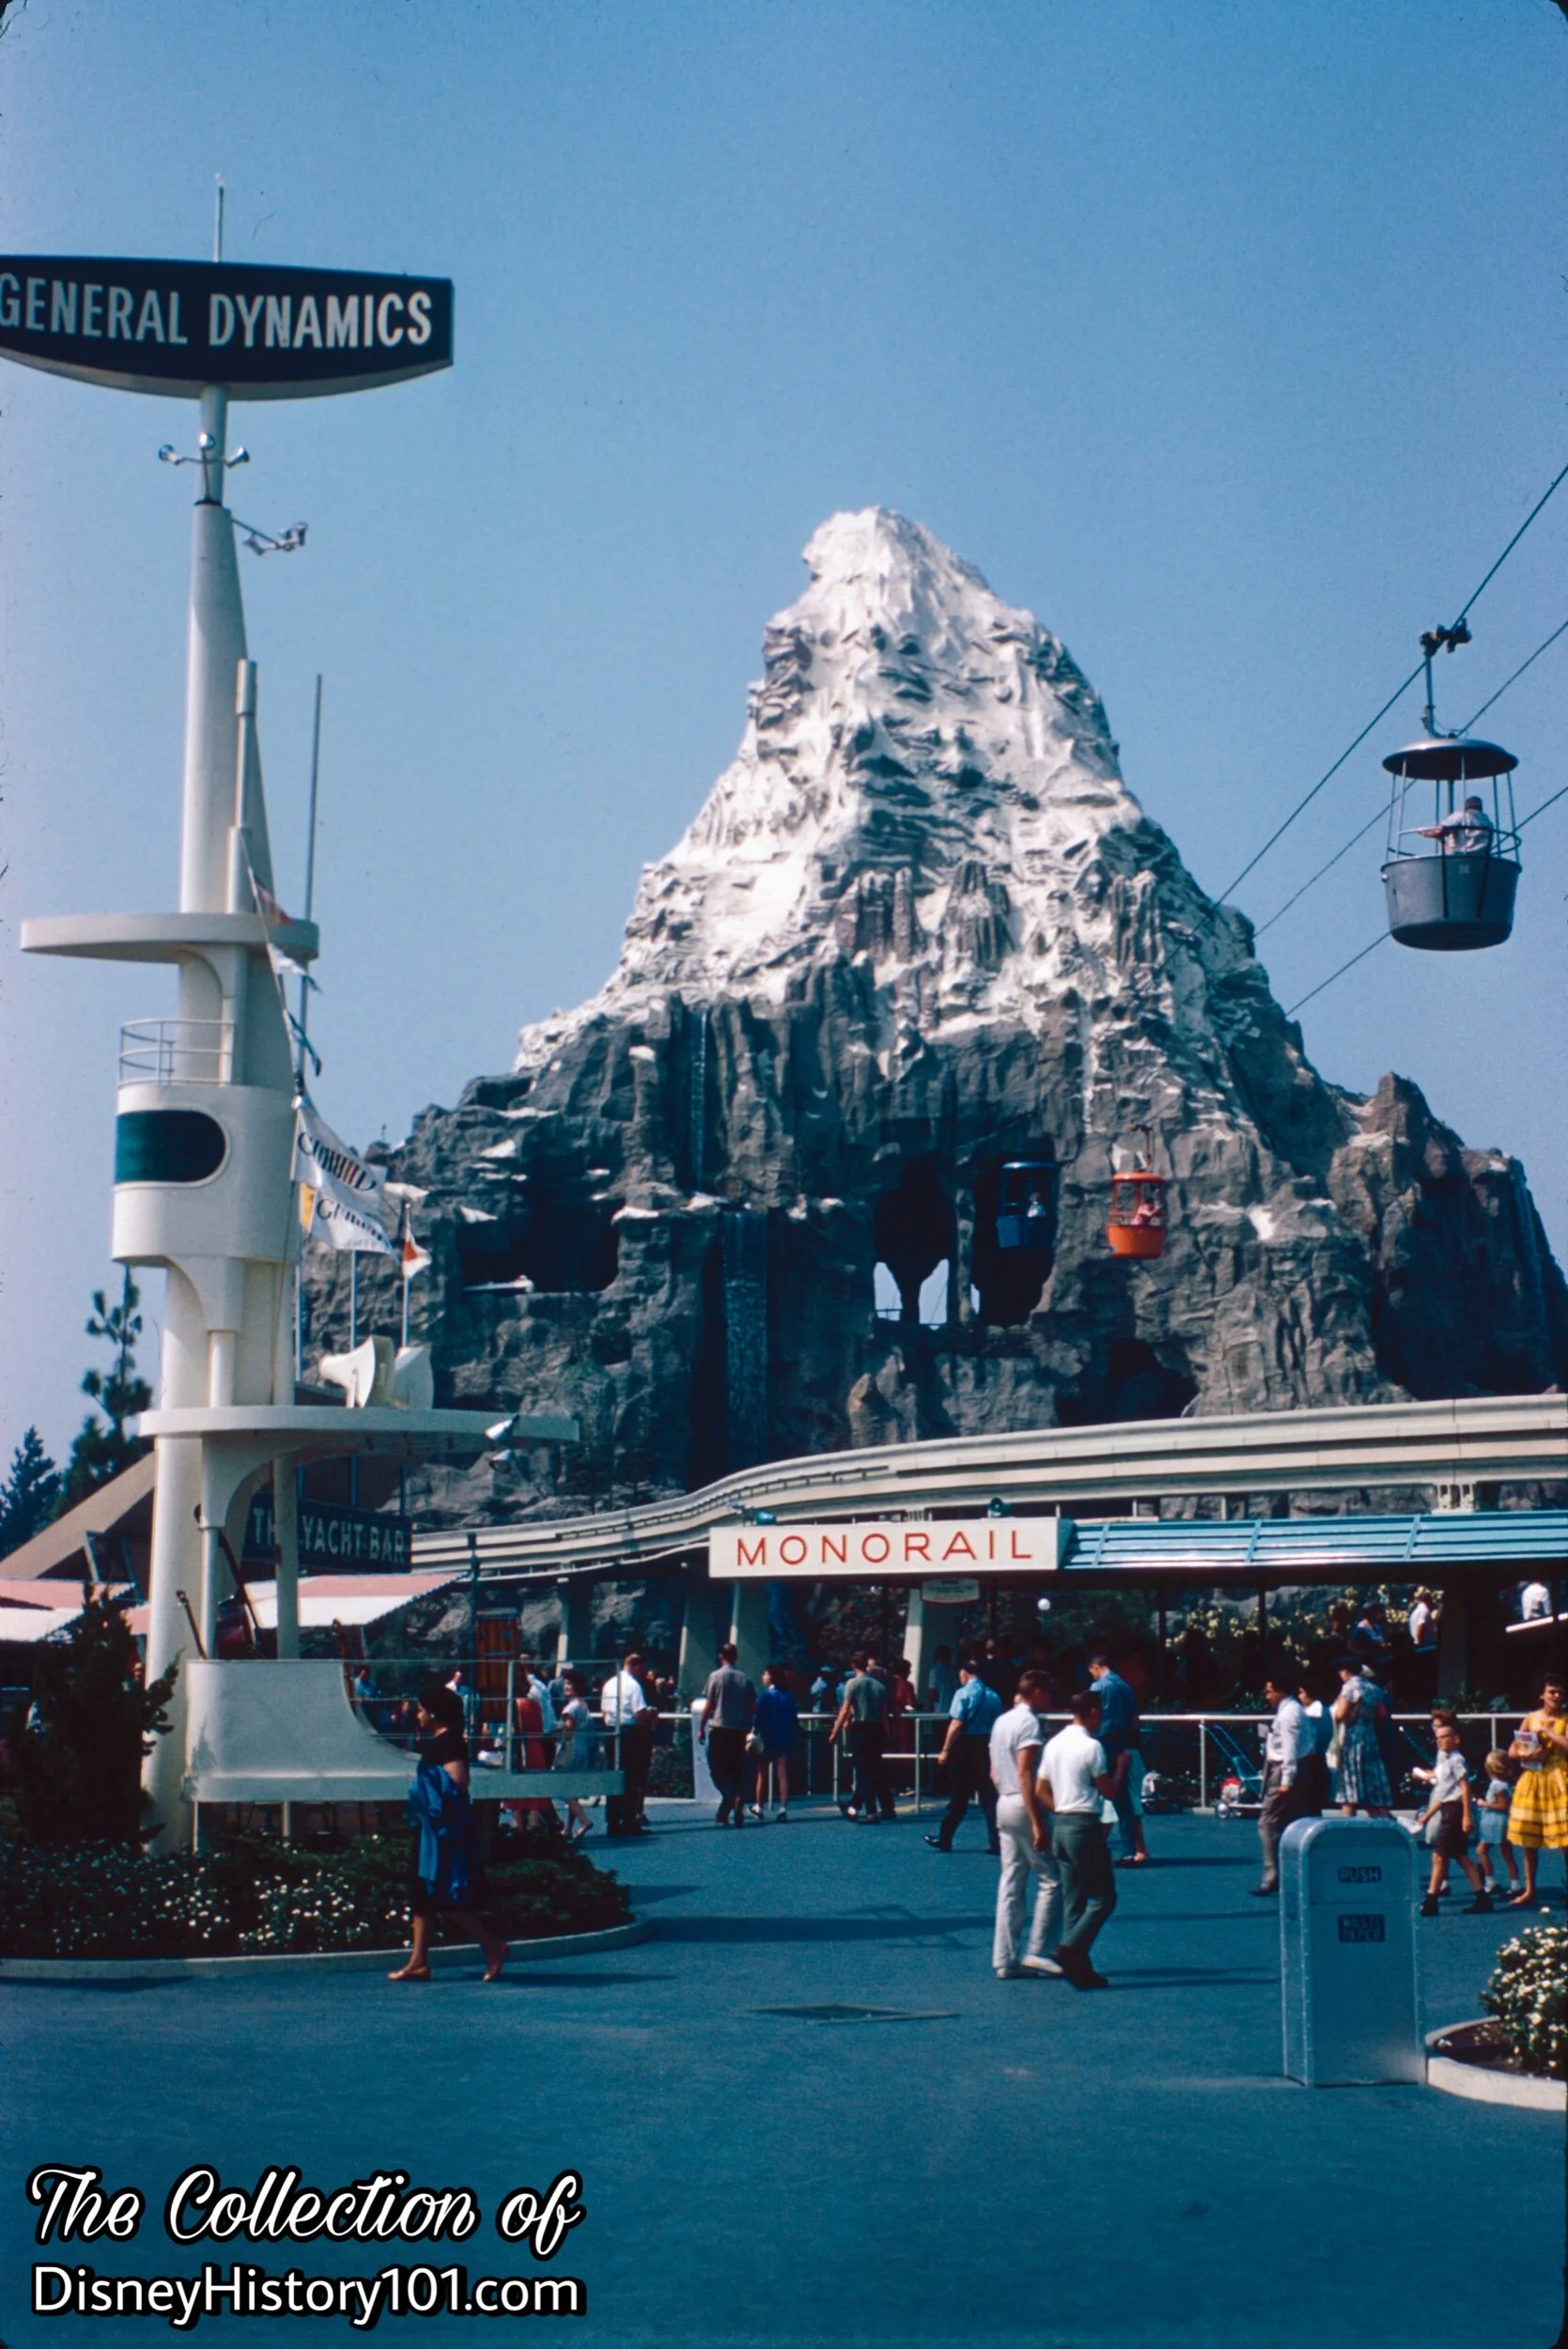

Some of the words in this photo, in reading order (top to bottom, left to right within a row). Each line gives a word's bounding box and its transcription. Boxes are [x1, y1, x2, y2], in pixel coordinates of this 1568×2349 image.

[0, 273, 188, 344] GENERAL
[209, 291, 432, 349] DYNAMICS
[253, 1507, 275, 1546] TH
[302, 1515, 365, 1558] YACHT
[369, 1526, 405, 1564] BAR
[737, 1531, 1032, 1566] MONORAIL
[1341, 1868, 1379, 1881] PUSH
